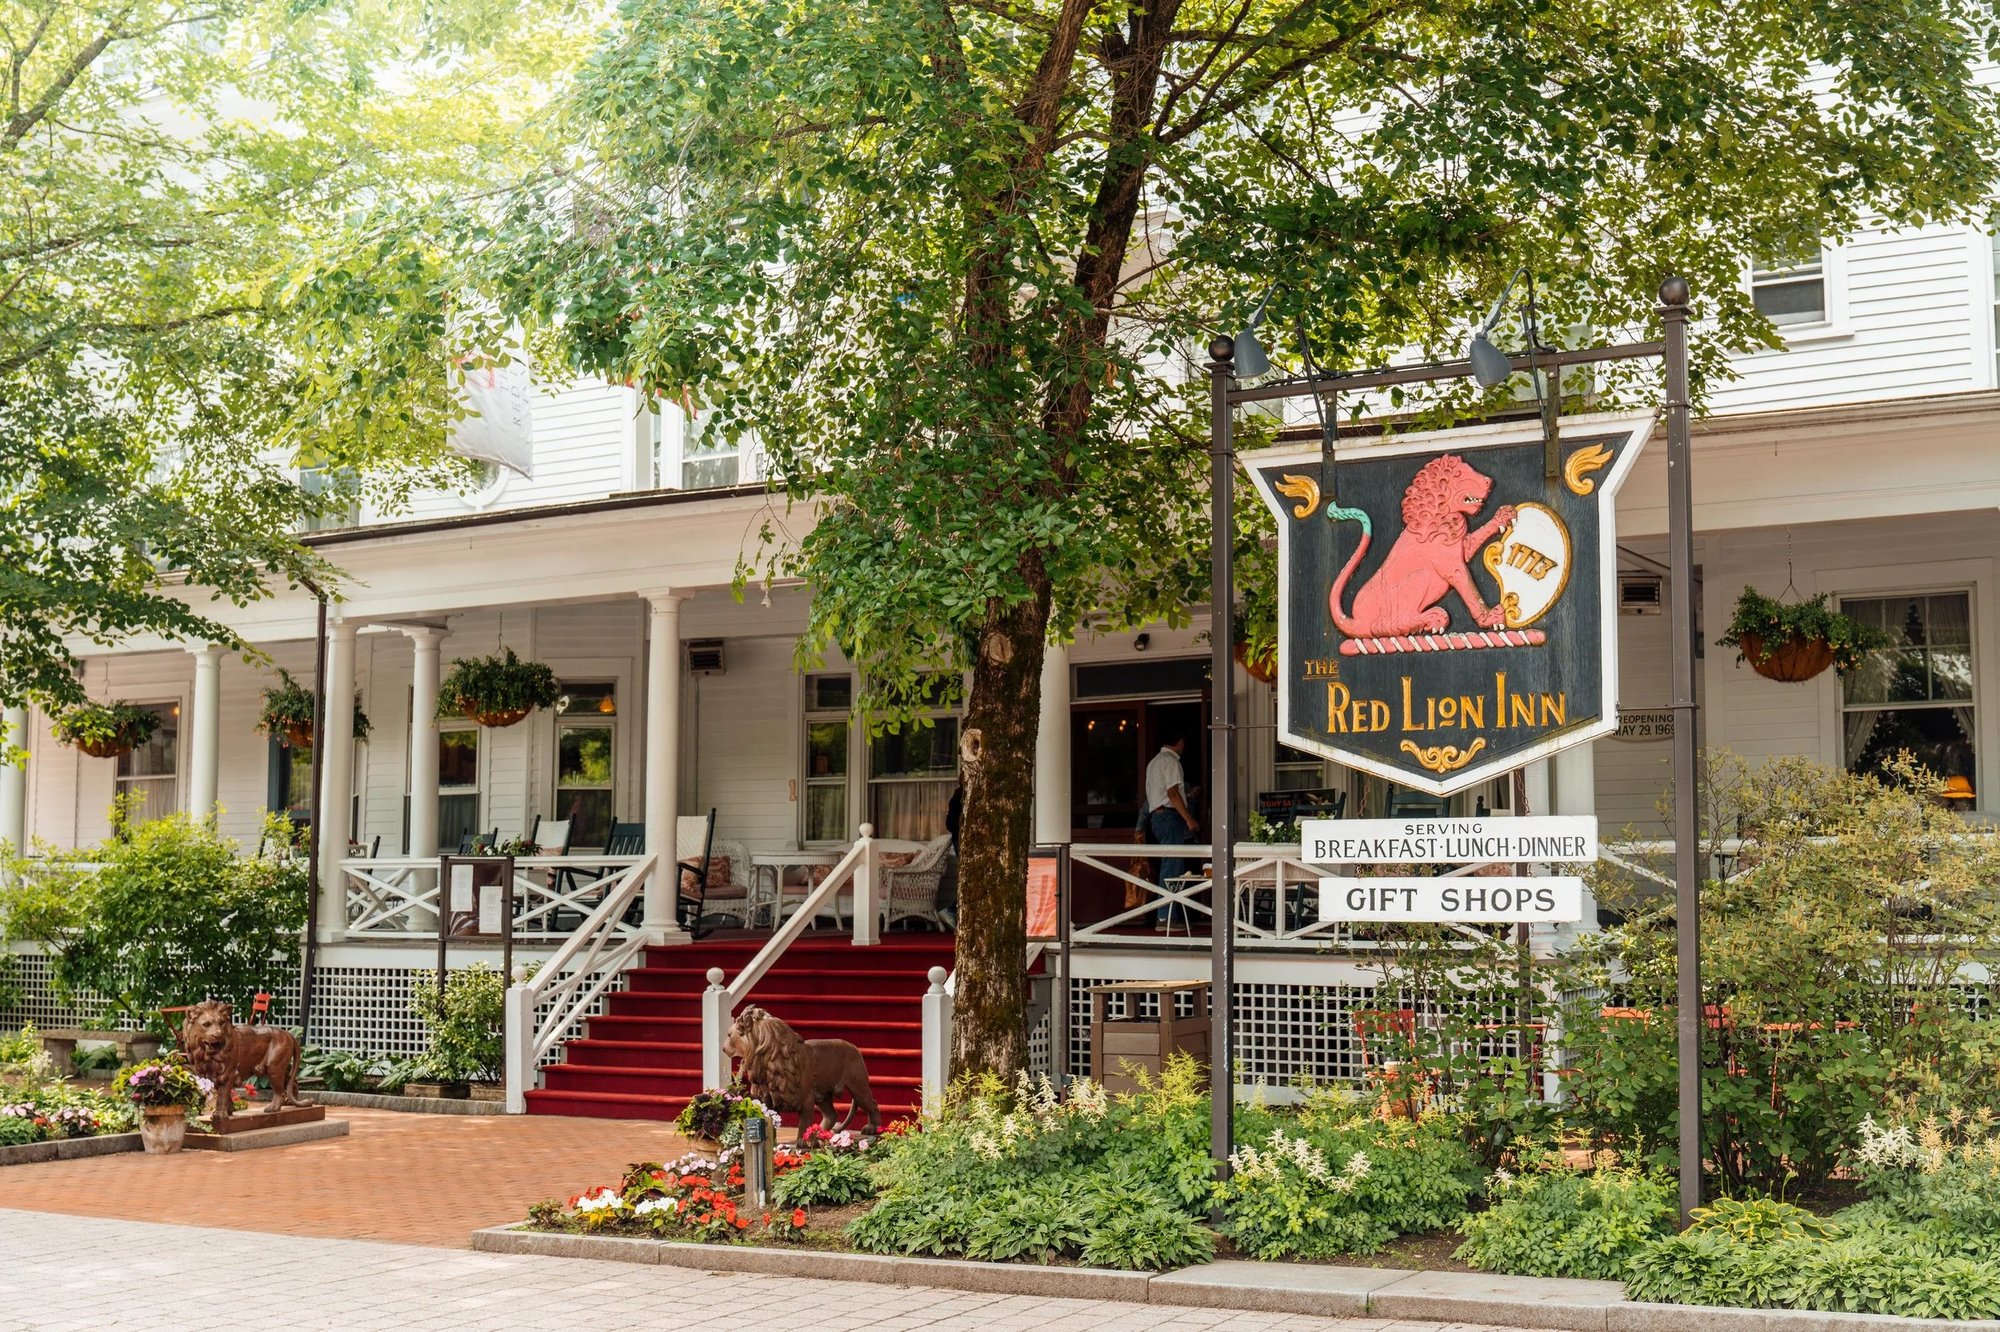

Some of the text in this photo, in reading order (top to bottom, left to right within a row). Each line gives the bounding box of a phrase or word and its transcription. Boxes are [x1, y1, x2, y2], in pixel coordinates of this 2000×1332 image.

[1506, 543, 1558, 581] 1773
[1304, 660, 1339, 675] THE
[1327, 671, 1566, 733] RED LION INN
[1617, 714, 1674, 724] REOPENING
[1404, 823, 1483, 836] SERVING
[1346, 887, 1555, 912] GIFT SHOPS
